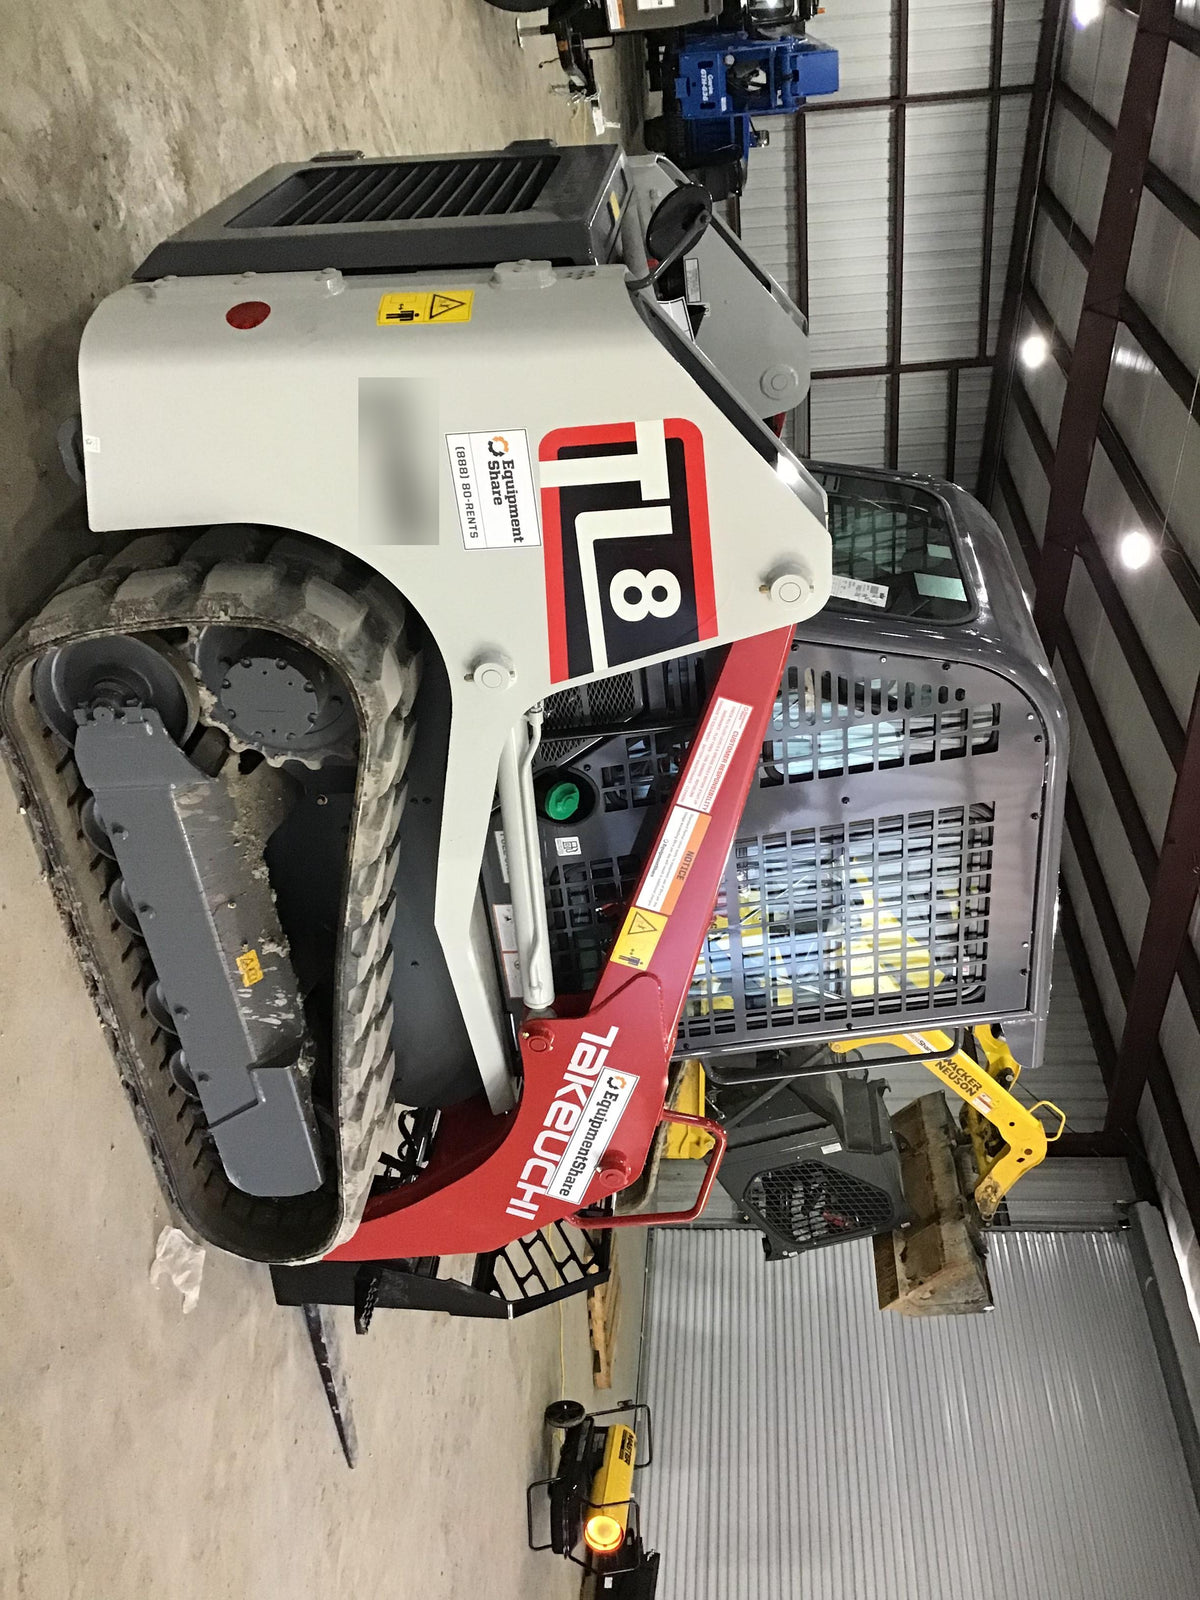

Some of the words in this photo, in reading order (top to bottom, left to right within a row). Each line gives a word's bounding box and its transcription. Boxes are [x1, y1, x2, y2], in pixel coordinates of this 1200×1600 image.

[454, 446, 470, 479] (888)
[486, 460, 505, 506] Share
[460, 483, 479, 539] 80-RENTS
[500, 459, 525, 544] Equipment
[720, 730, 740, 764] CUSTOMER
[702, 764, 729, 812] RESPONSIBILITY
[676, 850, 696, 881] NOTICE
[934, 1061, 976, 1096] NEUSON
[943, 1058, 983, 1092] WACKER
[558, 1090, 619, 1197] EquipmentShare
[624, 1432, 634, 1466] MASTER
